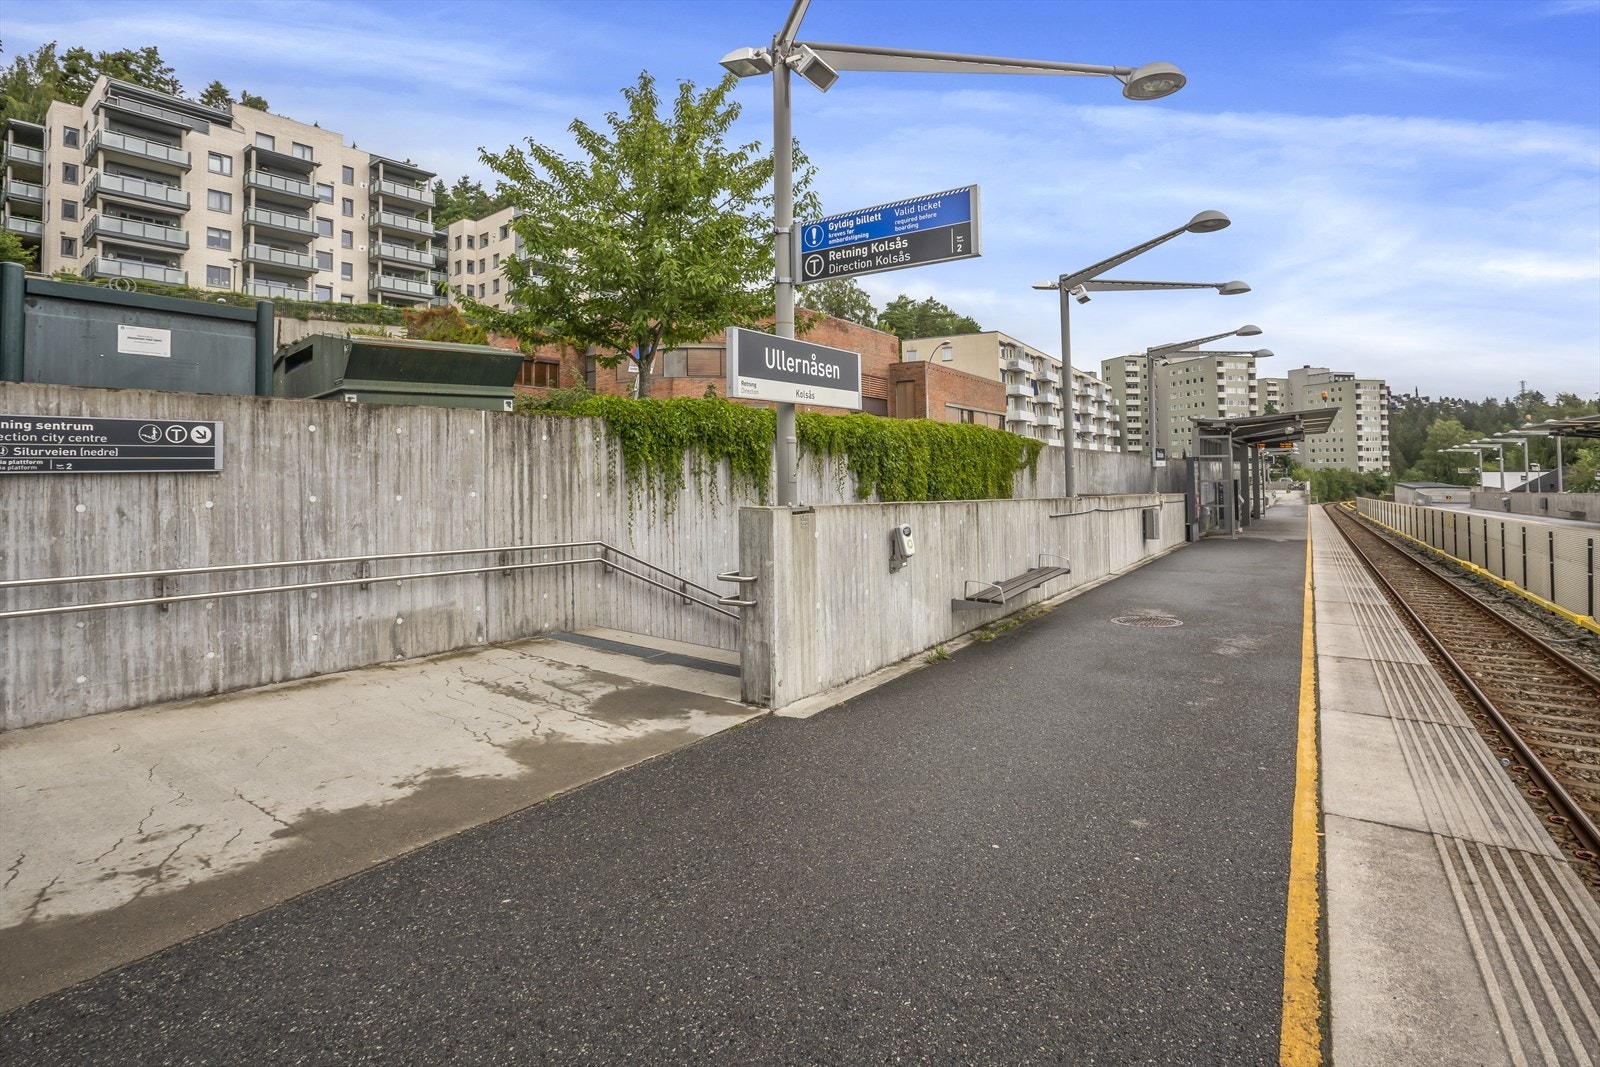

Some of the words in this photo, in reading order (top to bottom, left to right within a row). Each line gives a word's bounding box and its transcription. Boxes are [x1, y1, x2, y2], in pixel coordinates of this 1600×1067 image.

[894, 207, 915, 217] Valid
[917, 200, 941, 212] ticket
[829, 219, 854, 231] Gyldig
[856, 213, 881, 225] billett
[895, 216, 917, 225] required
[918, 212, 937, 221] before
[895, 223, 918, 232] boarding
[828, 230, 846, 238] kreves
[829, 233, 868, 244] ombordstigning
[829, 247, 868, 260] Retning
[872, 237, 908, 252] Kolsås
[957, 244, 962, 252] 2
[829, 259, 872, 274] Direction
[876, 251, 910, 266] Kolsås
[765, 347, 840, 379] Ullernåsen
[795, 389, 815, 400] Kolsås
[1, 420, 32, 432] ning
[36, 422, 94, 431] sentrum
[41, 433, 65, 444] city
[68, 435, 107, 443] centre
[13, 447, 77, 457] Silurveien
[80, 447, 119, 457] (nedre)
